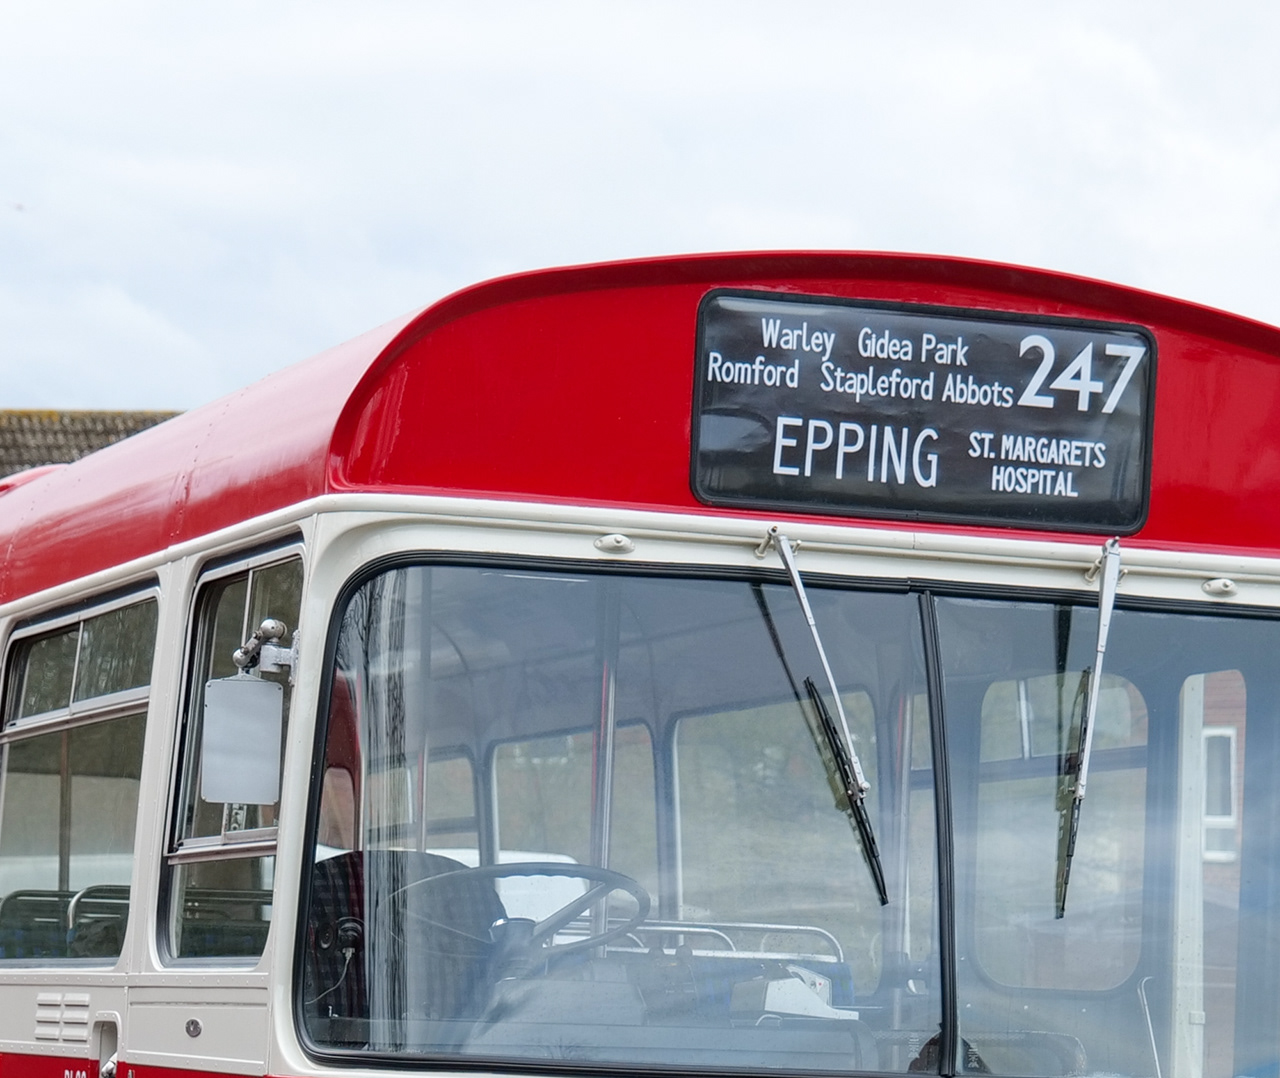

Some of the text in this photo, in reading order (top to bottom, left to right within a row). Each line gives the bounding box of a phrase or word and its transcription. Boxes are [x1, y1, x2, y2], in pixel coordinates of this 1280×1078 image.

[761, 318, 968, 368] Warley Gidea Park
[707, 352, 1014, 409] Romford Stapleford Abbots
[1017, 334, 1147, 414] 247
[772, 416, 939, 488] EPPING
[968, 431, 1106, 469] ST. MARGARETS
[991, 465, 1079, 498] HOSPITAL
